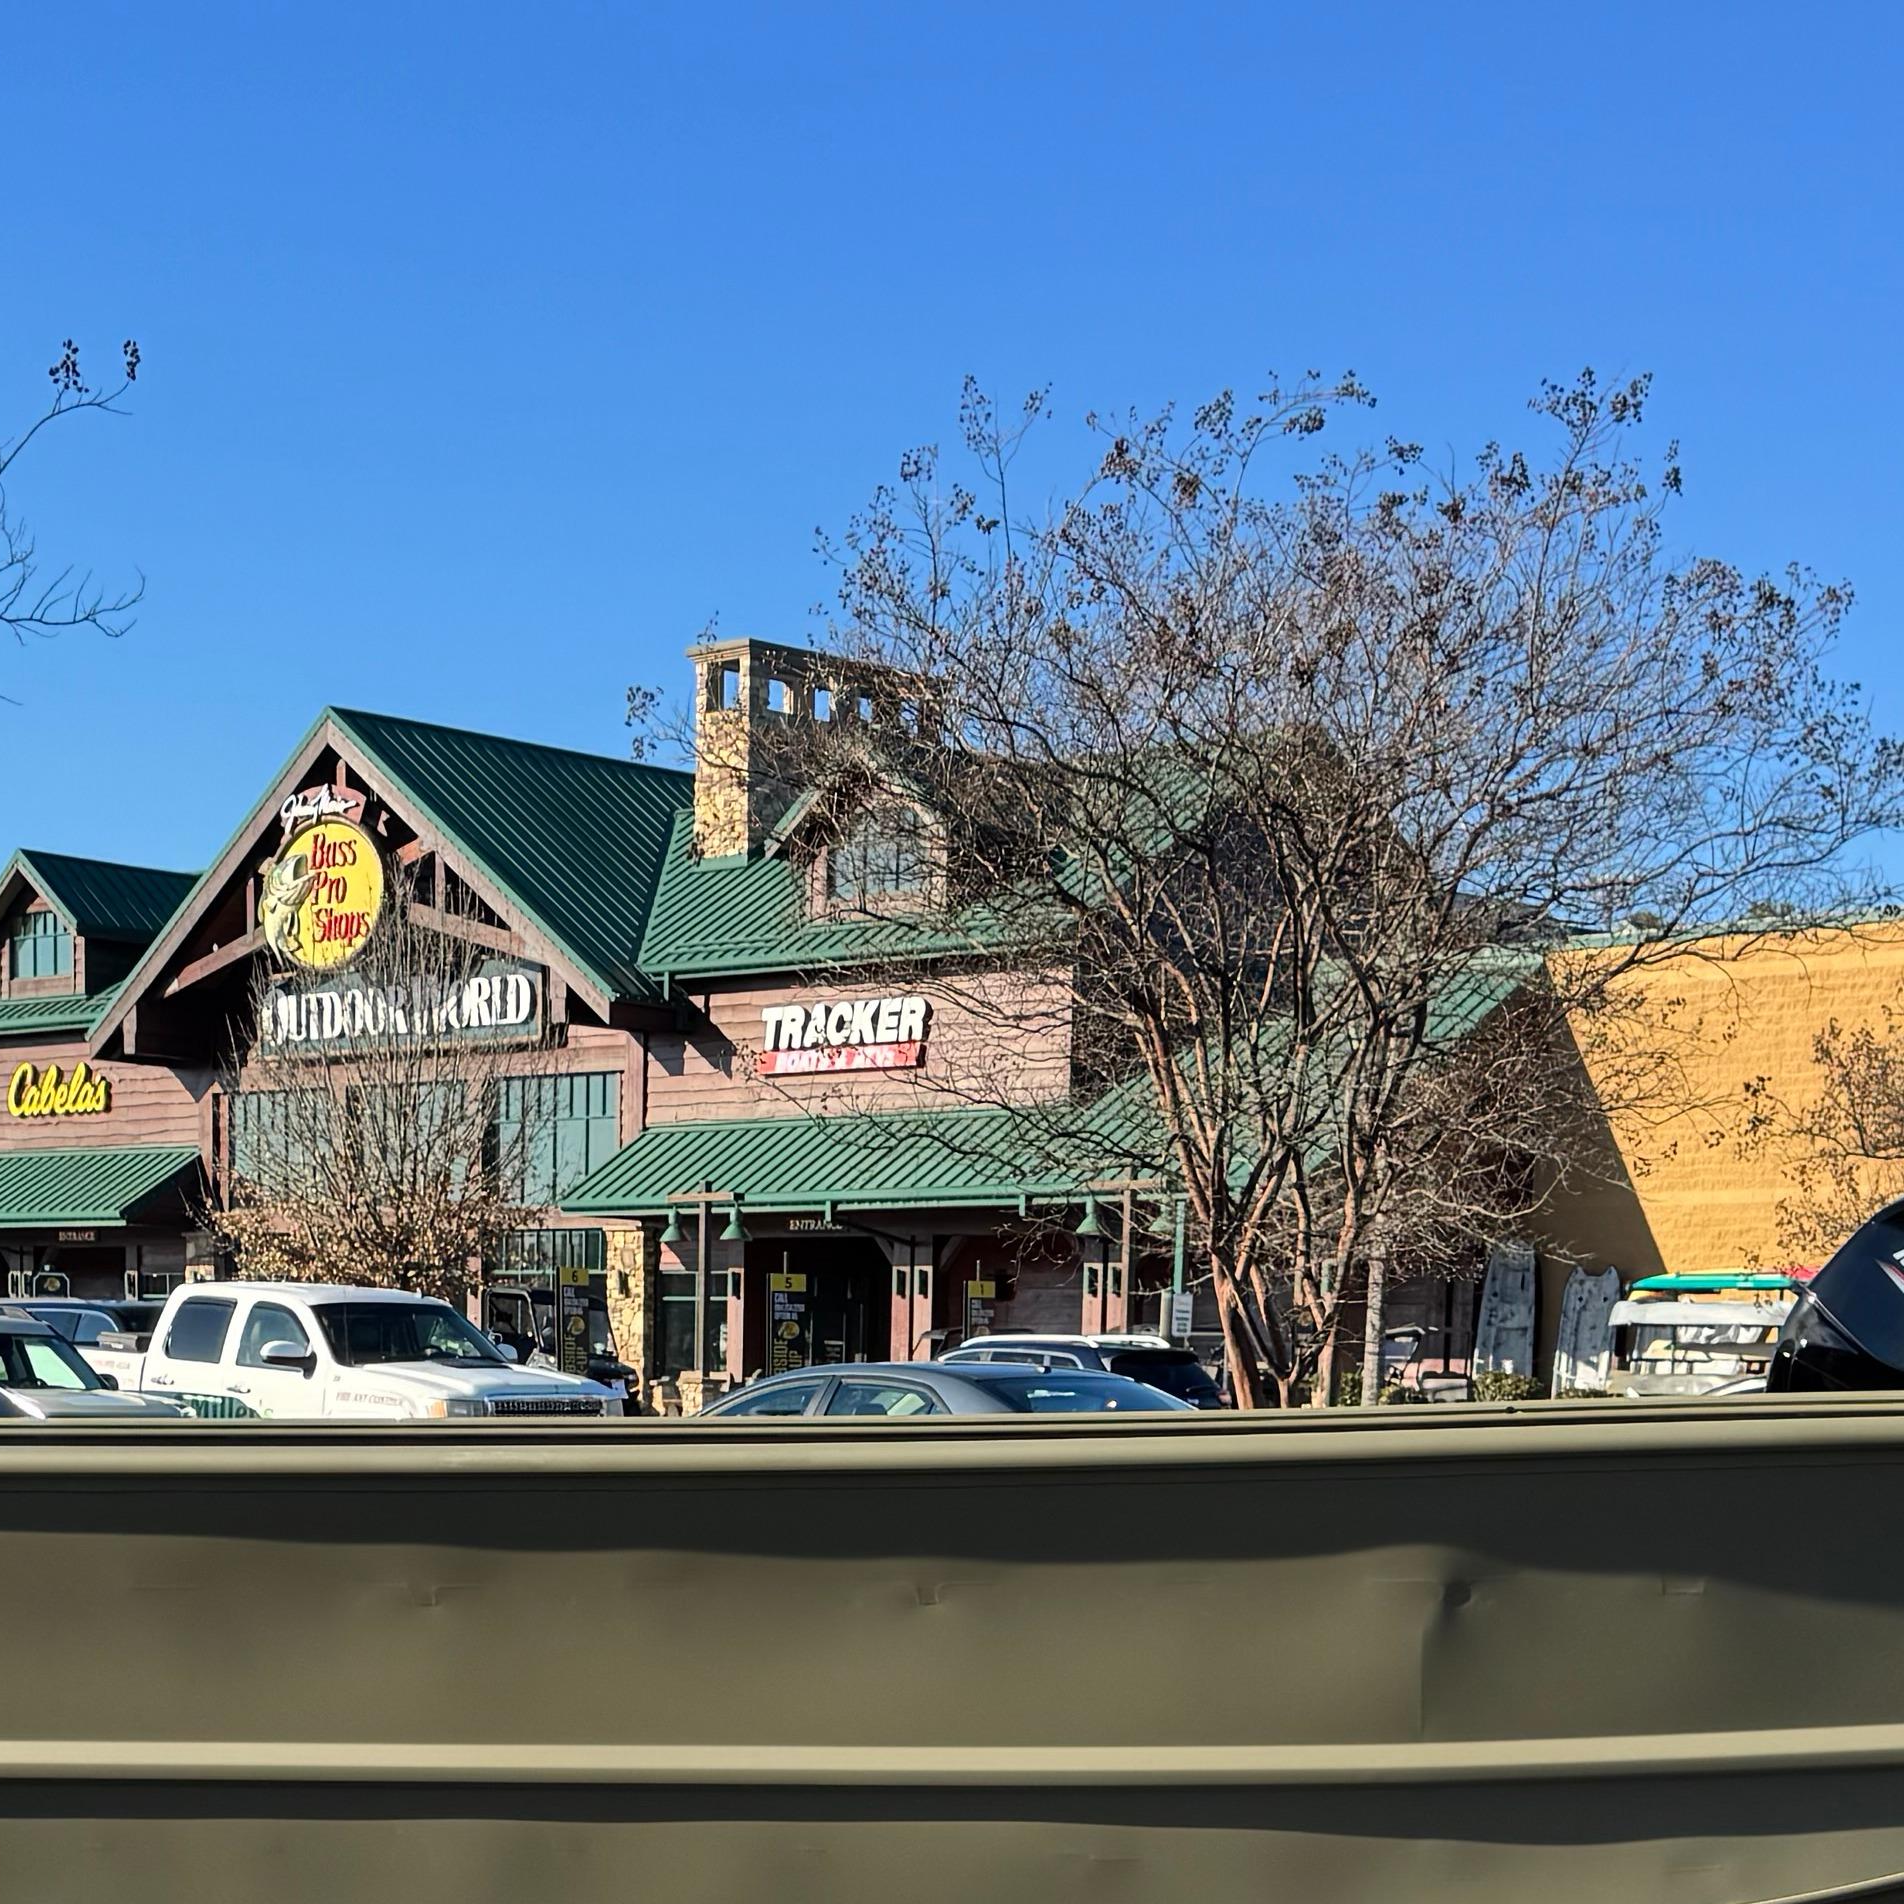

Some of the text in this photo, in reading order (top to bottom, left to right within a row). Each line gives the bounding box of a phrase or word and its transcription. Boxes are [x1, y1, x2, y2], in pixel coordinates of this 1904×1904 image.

[310, 832, 357, 870] Bass
[311, 870, 348, 906] Pro
[315, 907, 371, 948] Shops
[410, 974, 531, 1034] WORLD
[761, 996, 929, 1051] TRACKER
[8, 1061, 109, 1117] Cabela's
[571, 1270, 578, 1283] 6
[784, 1278, 792, 1289] 5
